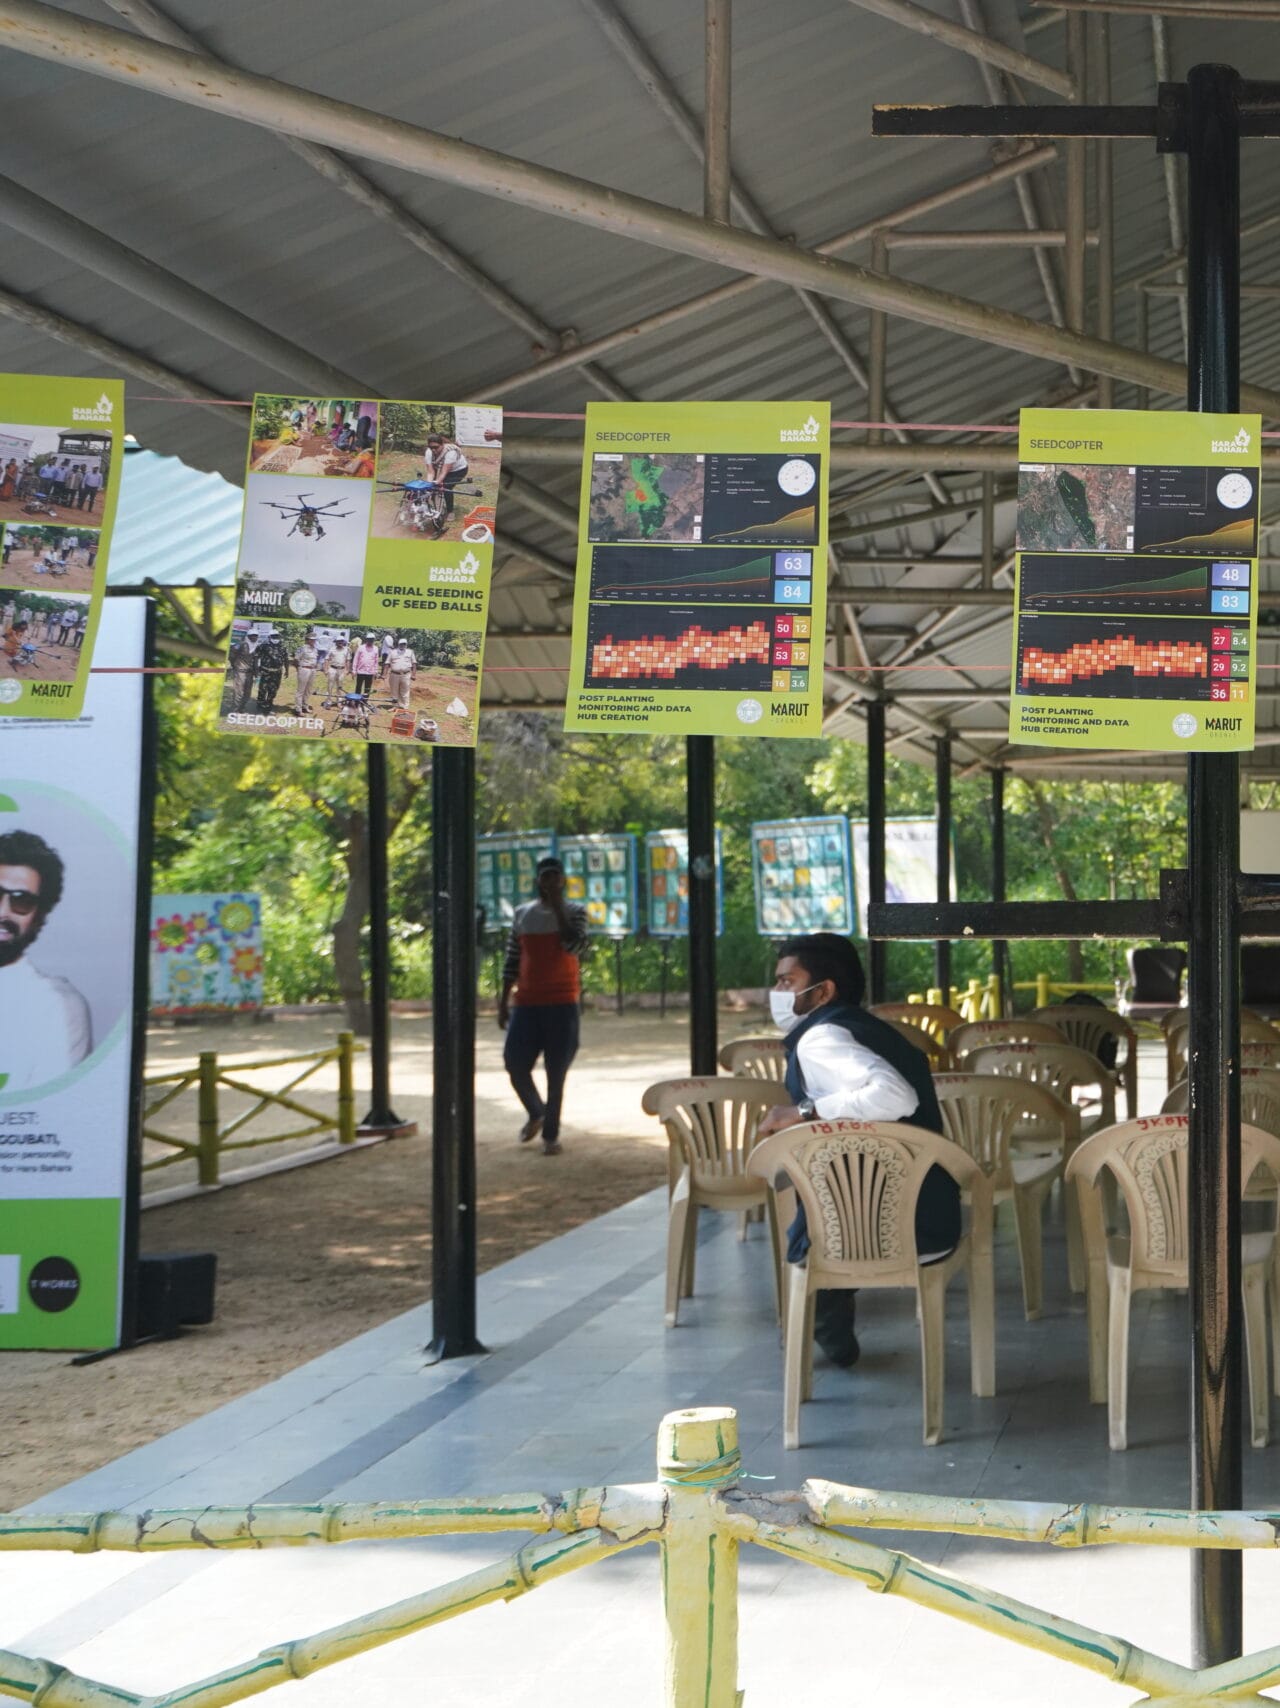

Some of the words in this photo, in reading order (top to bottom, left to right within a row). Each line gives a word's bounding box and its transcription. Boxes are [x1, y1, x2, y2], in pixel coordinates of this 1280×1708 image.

[72, 414, 112, 422] BAHARA
[595, 432, 670, 442] SEEDCOPTER
[780, 434, 818, 443] BAHARA
[1030, 439, 1103, 450] SEEDCOPTER
[784, 557, 802, 570] 63
[430, 567, 462, 576] HARA
[1222, 569, 1240, 581] 48
[429, 574, 476, 584] BAHARA
[375, 585, 423, 597] AERIAL
[427, 587, 484, 600] SEEDING
[783, 585, 802, 598] 84
[244, 590, 285, 606] MARUT
[1221, 595, 1239, 608] 83
[382, 599, 400, 608] OF
[403, 600, 437, 611] SEED
[441, 602, 482, 612] BALLS
[777, 623, 790, 633] 50
[795, 624, 807, 633] 12
[1213, 636, 1226, 646] 27
[1232, 636, 1247, 646] 8.4
[775, 651, 788, 660] 53
[794, 651, 806, 660] 12
[1213, 663, 1226, 672] 29
[1232, 663, 1246, 672] 9.2
[775, 679, 785, 688] 16
[791, 679, 805, 689] 3.6
[30, 683, 73, 698] MARUT
[1212, 689, 1226, 699] 36
[1231, 690, 1244, 699] 11
[607, 695, 655, 703] PLANTING
[578, 703, 640, 712] MONITORING
[642, 704, 663, 712] AND
[665, 704, 692, 713] DATA
[771, 703, 810, 717] MARUT
[1048, 707, 1094, 716] PLANTING
[227, 713, 324, 730] SEEDCOPTER
[577, 713, 598, 721] HUB
[600, 713, 649, 721] CREATION
[1021, 716, 1082, 725] MONITORING
[1084, 718, 1103, 726] AND
[1104, 718, 1129, 727] DATA
[1205, 717, 1243, 731] MARUT
[1042, 726, 1089, 734] CREATION
